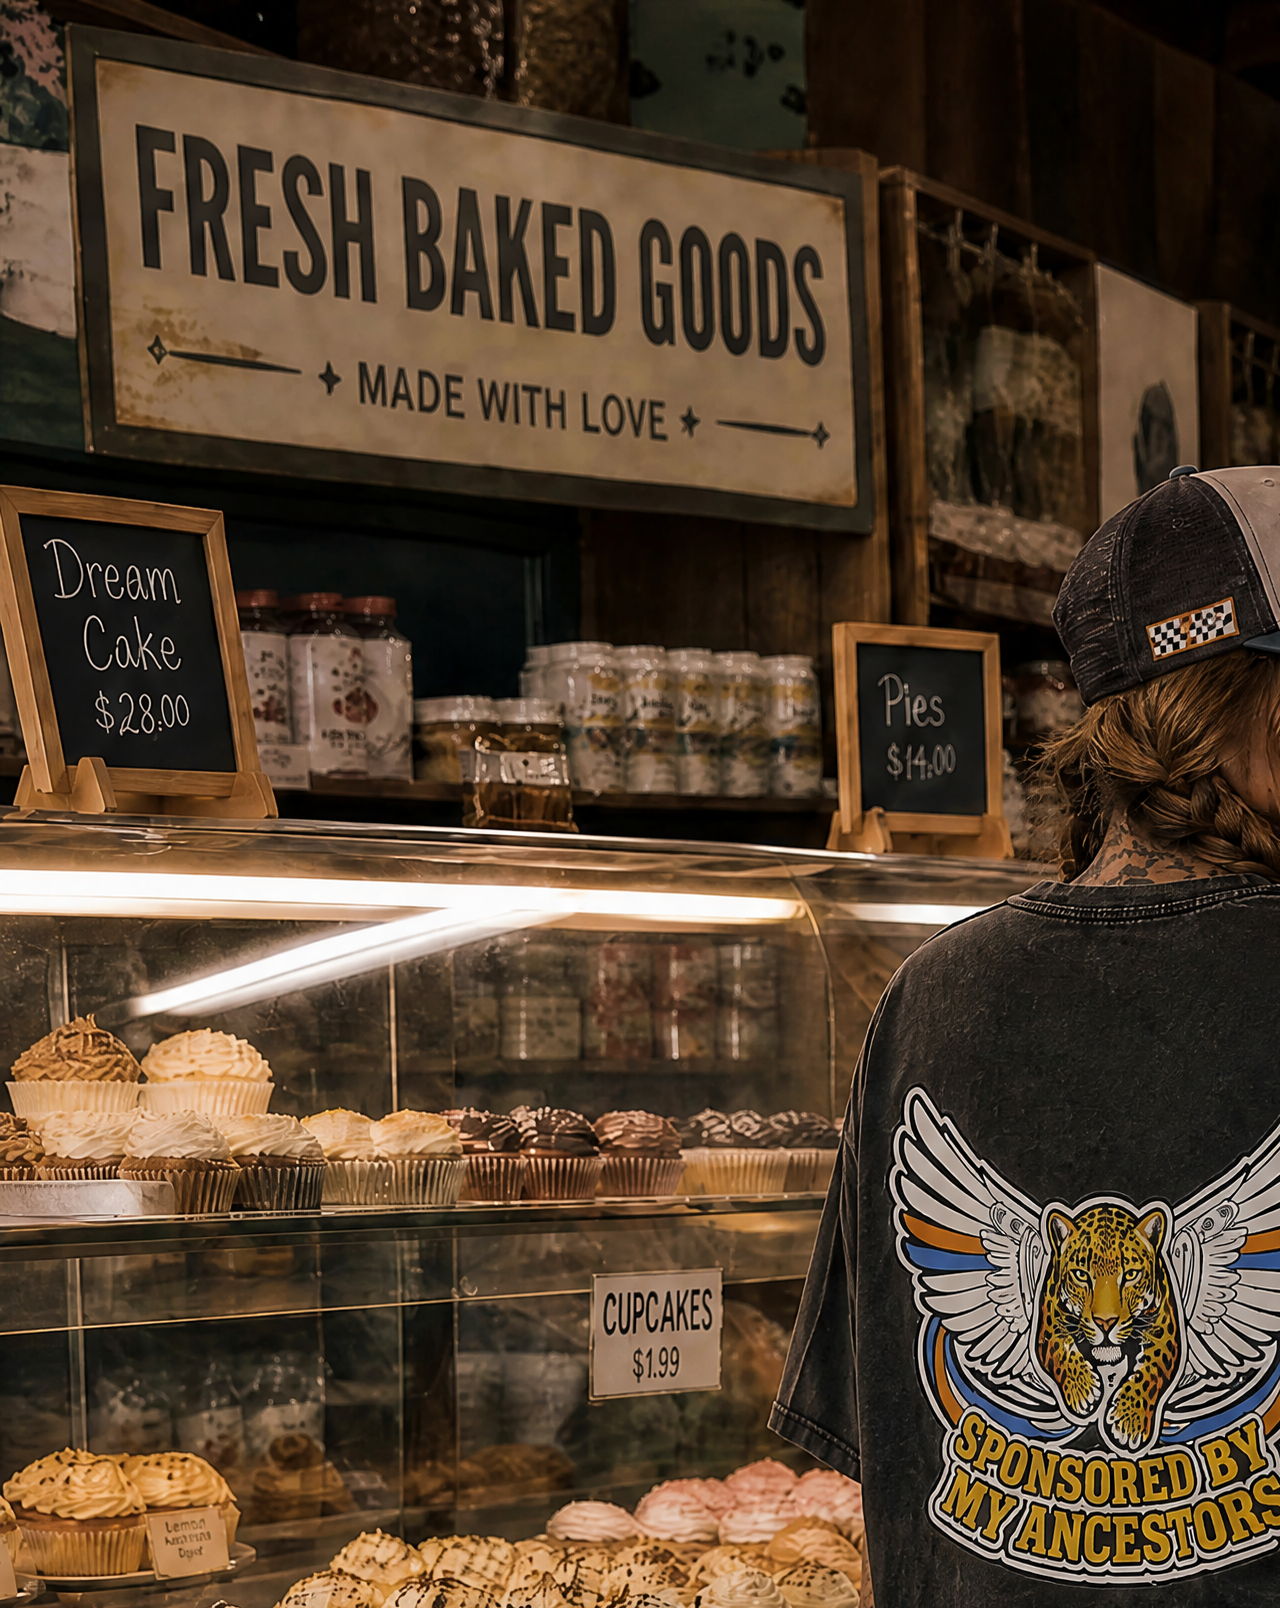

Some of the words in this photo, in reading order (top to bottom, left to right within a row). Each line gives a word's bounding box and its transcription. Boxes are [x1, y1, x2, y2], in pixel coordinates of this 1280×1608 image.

[135, 124, 378, 304] FRESH
[401, 175, 616, 336] BAKED
[639, 218, 825, 367] GOODS
[358, 361, 464, 419] MADE
[477, 378, 568, 431] WITH
[582, 392, 669, 443] LOVE
[43, 538, 182, 605] Dream
[83, 614, 182, 671] Cake
[95, 690, 190, 736] $28.00
[877, 672, 946, 728] Pies
[886, 742, 957, 781] $14.00
[603, 1287, 713, 1336] CUPCAKES
[632, 1346, 680, 1384] $1.99
[953, 1412, 1196, 1507] SPONSORED
[1200, 1420, 1269, 1488] BY
[941, 1468, 1017, 1542] MY
